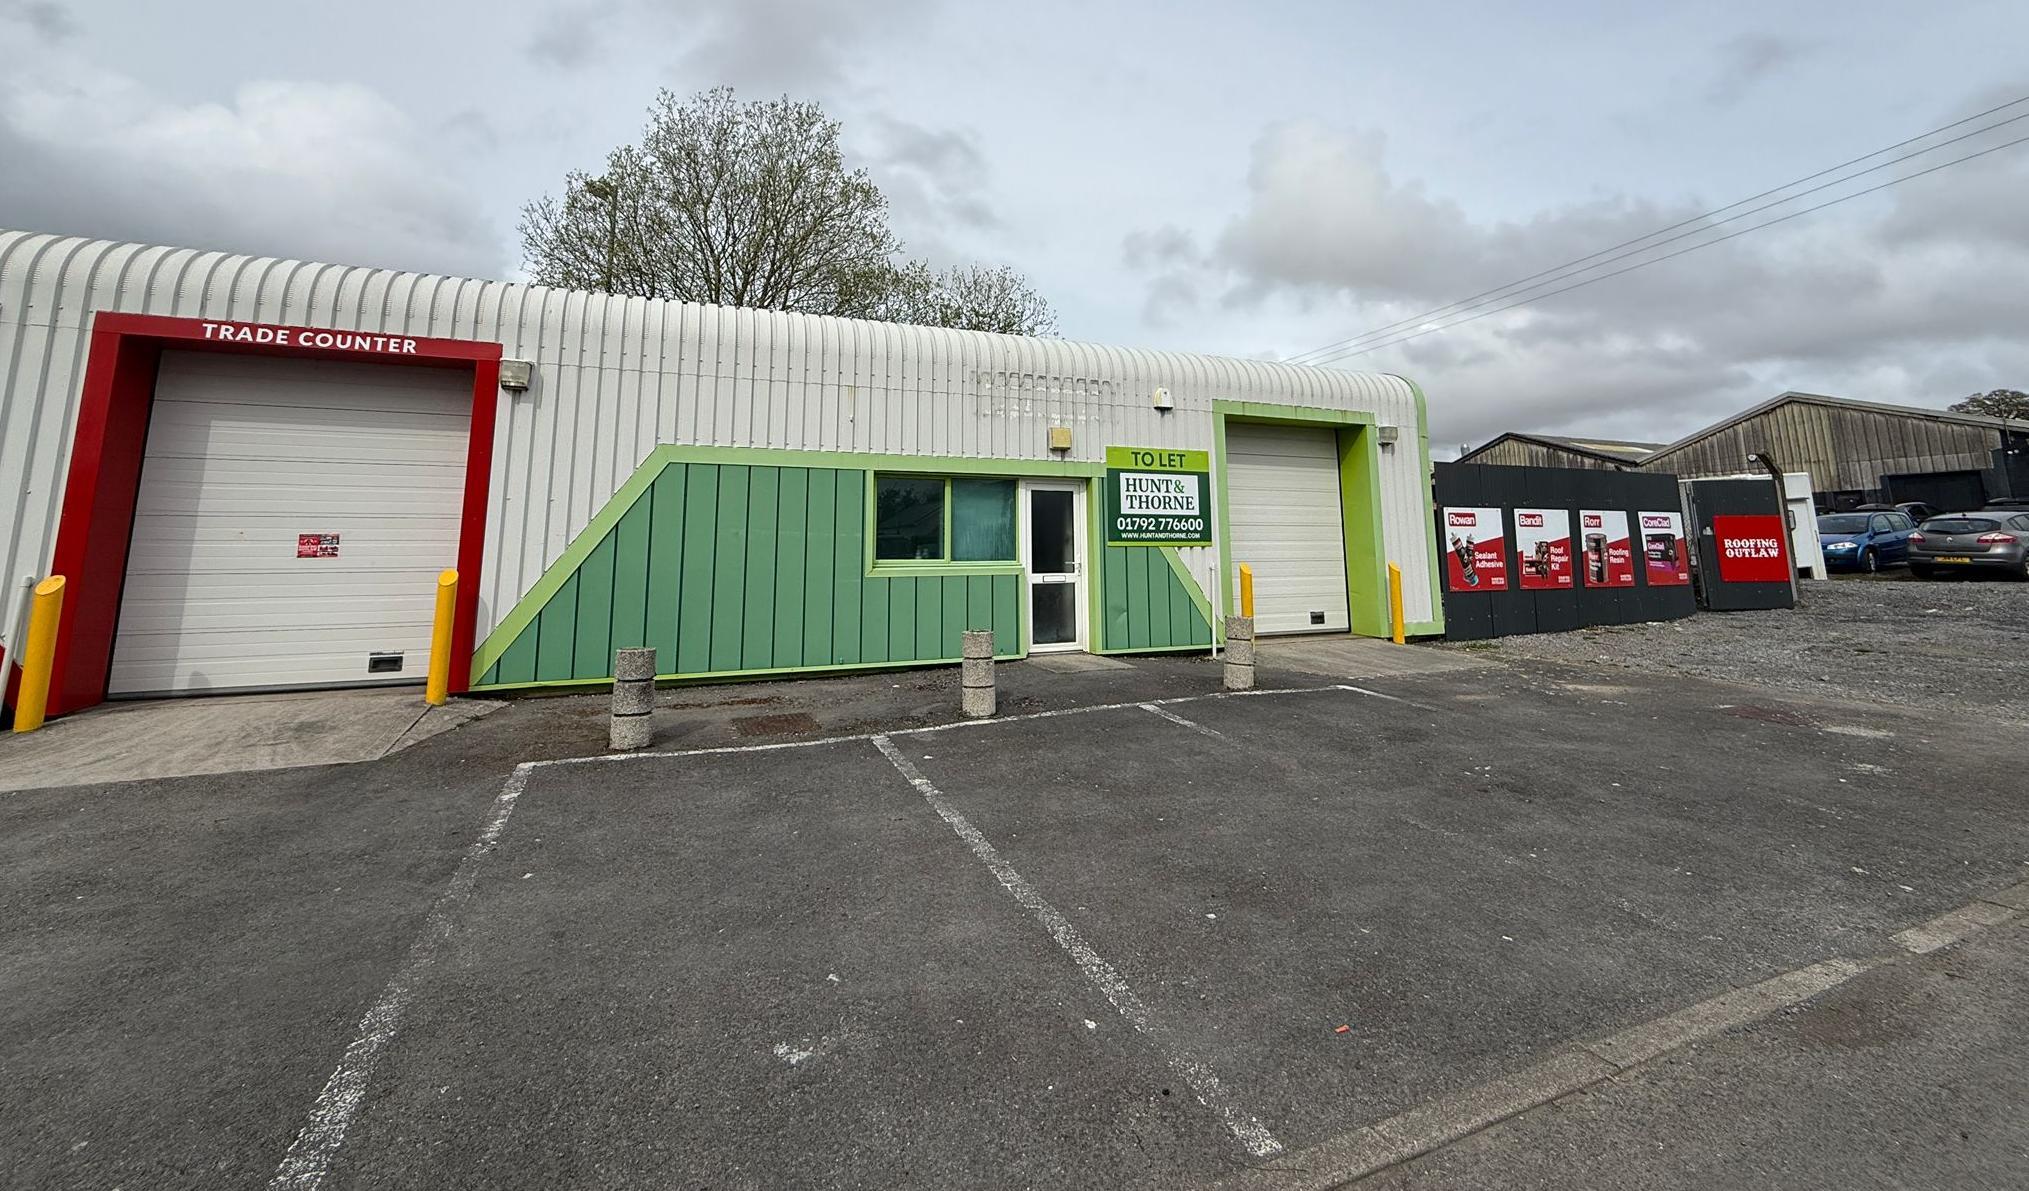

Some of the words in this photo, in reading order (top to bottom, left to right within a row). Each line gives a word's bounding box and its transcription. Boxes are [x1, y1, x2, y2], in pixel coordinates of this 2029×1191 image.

[202, 323, 289, 345] TRADE
[299, 331, 417, 353] COUNTER
[1131, 452, 1154, 467] TO
[1159, 453, 1186, 468] LET
[1126, 495, 1195, 510] THORNE
[1117, 517, 1156, 530] 01792
[1158, 518, 1203, 531] 776600
[1449, 514, 1475, 525] Rowan
[1519, 516, 1543, 526] Bandit
[1643, 518, 1671, 528] CoreClad
[1724, 538, 1778, 548] ROOFING
[1474, 551, 1497, 560] Sealant
[1608, 548, 1629, 557] Roofing
[1725, 548, 1779, 558] OUTLAW
[1550, 554, 1569, 563] Repair
[1609, 556, 1625, 564] Resin
[1475, 560, 1504, 568] Adhesive
